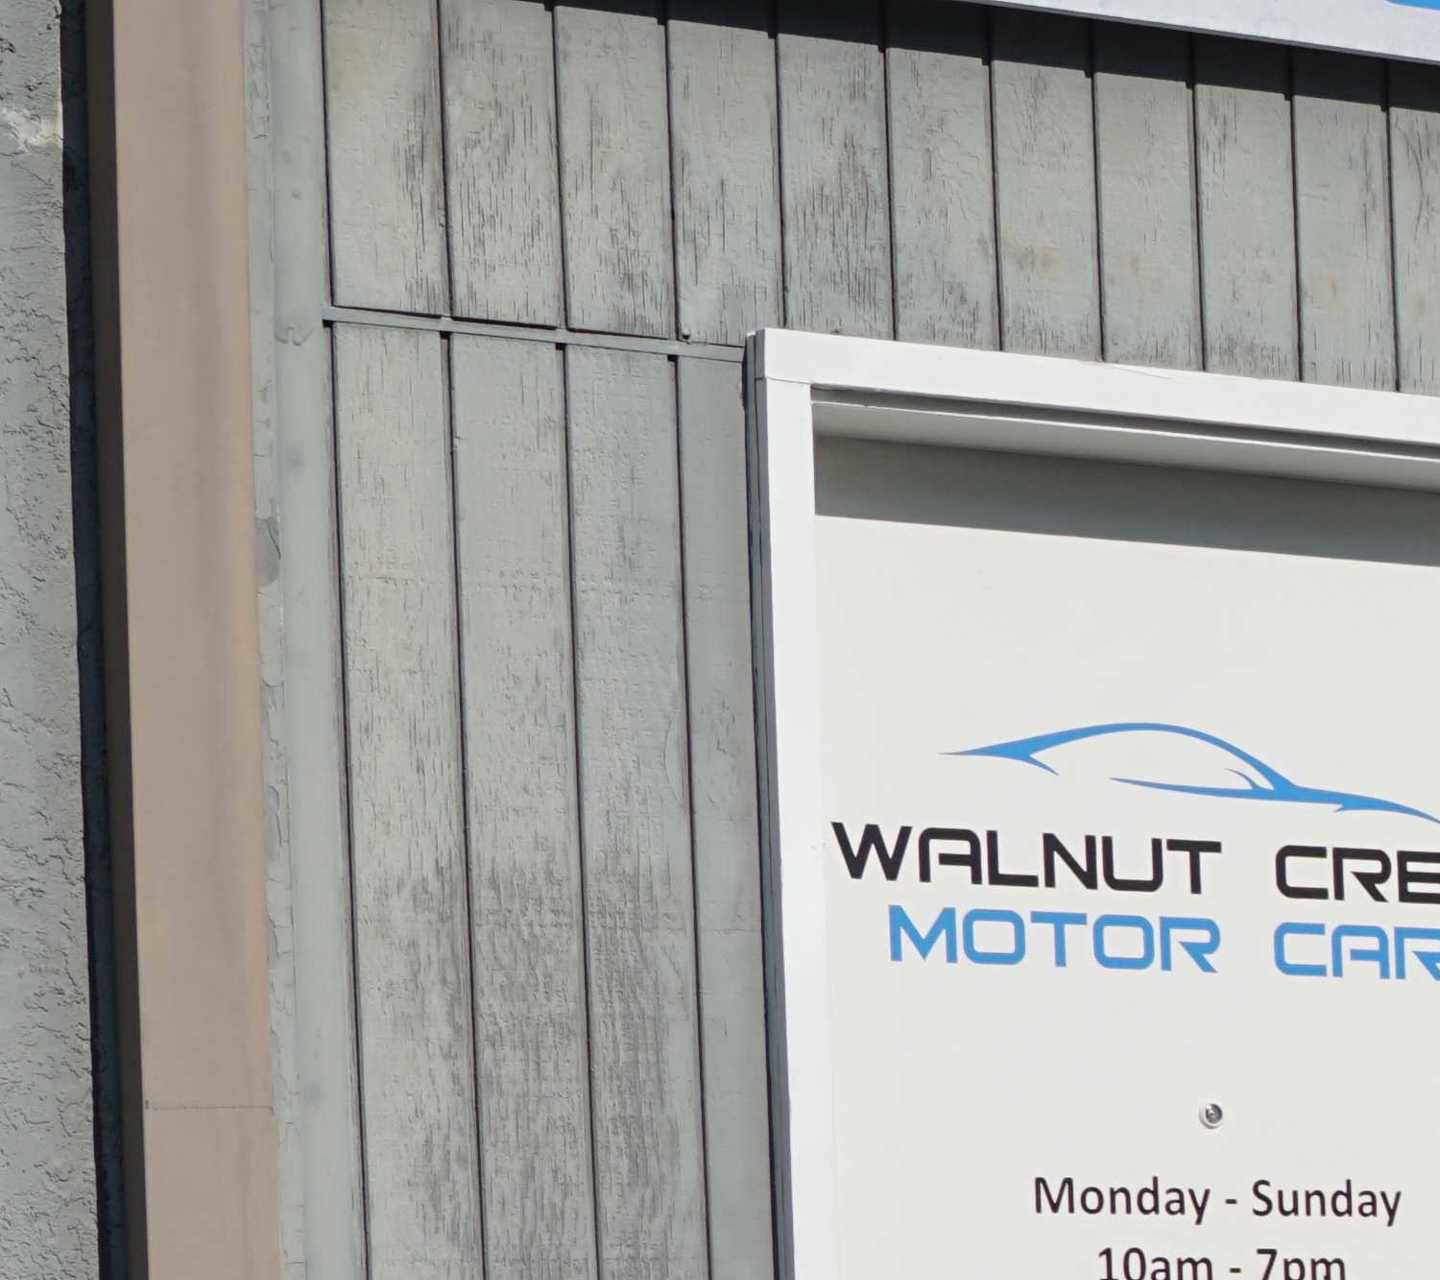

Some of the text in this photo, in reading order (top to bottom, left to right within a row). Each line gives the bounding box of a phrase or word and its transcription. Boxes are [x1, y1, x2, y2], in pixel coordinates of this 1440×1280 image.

[831, 821, 1221, 895] WALNUT
[887, 904, 1220, 973] MOTOR
[1033, 1176, 1211, 1226] Monday
[1251, 1179, 1402, 1227] Sunday
